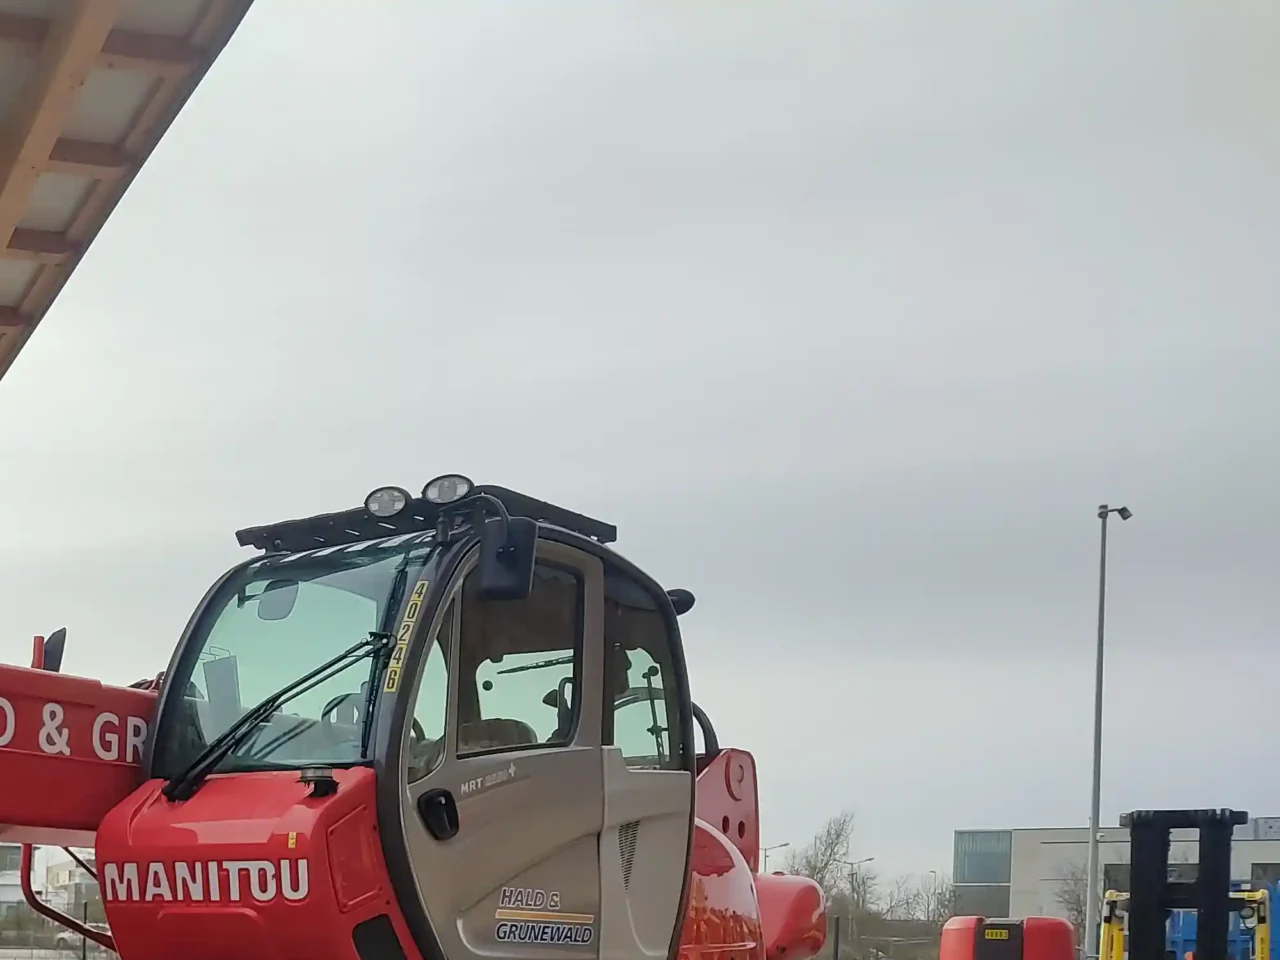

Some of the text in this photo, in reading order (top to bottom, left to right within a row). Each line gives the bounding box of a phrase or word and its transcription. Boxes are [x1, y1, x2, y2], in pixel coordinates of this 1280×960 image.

[386, 582, 425, 690] 40246
[38, 702, 71, 756] &
[460, 777, 483, 795] MRT
[103, 857, 309, 902] MANITOU
[499, 886, 561, 910] HALD &
[495, 922, 593, 945] GRUNEWALD
